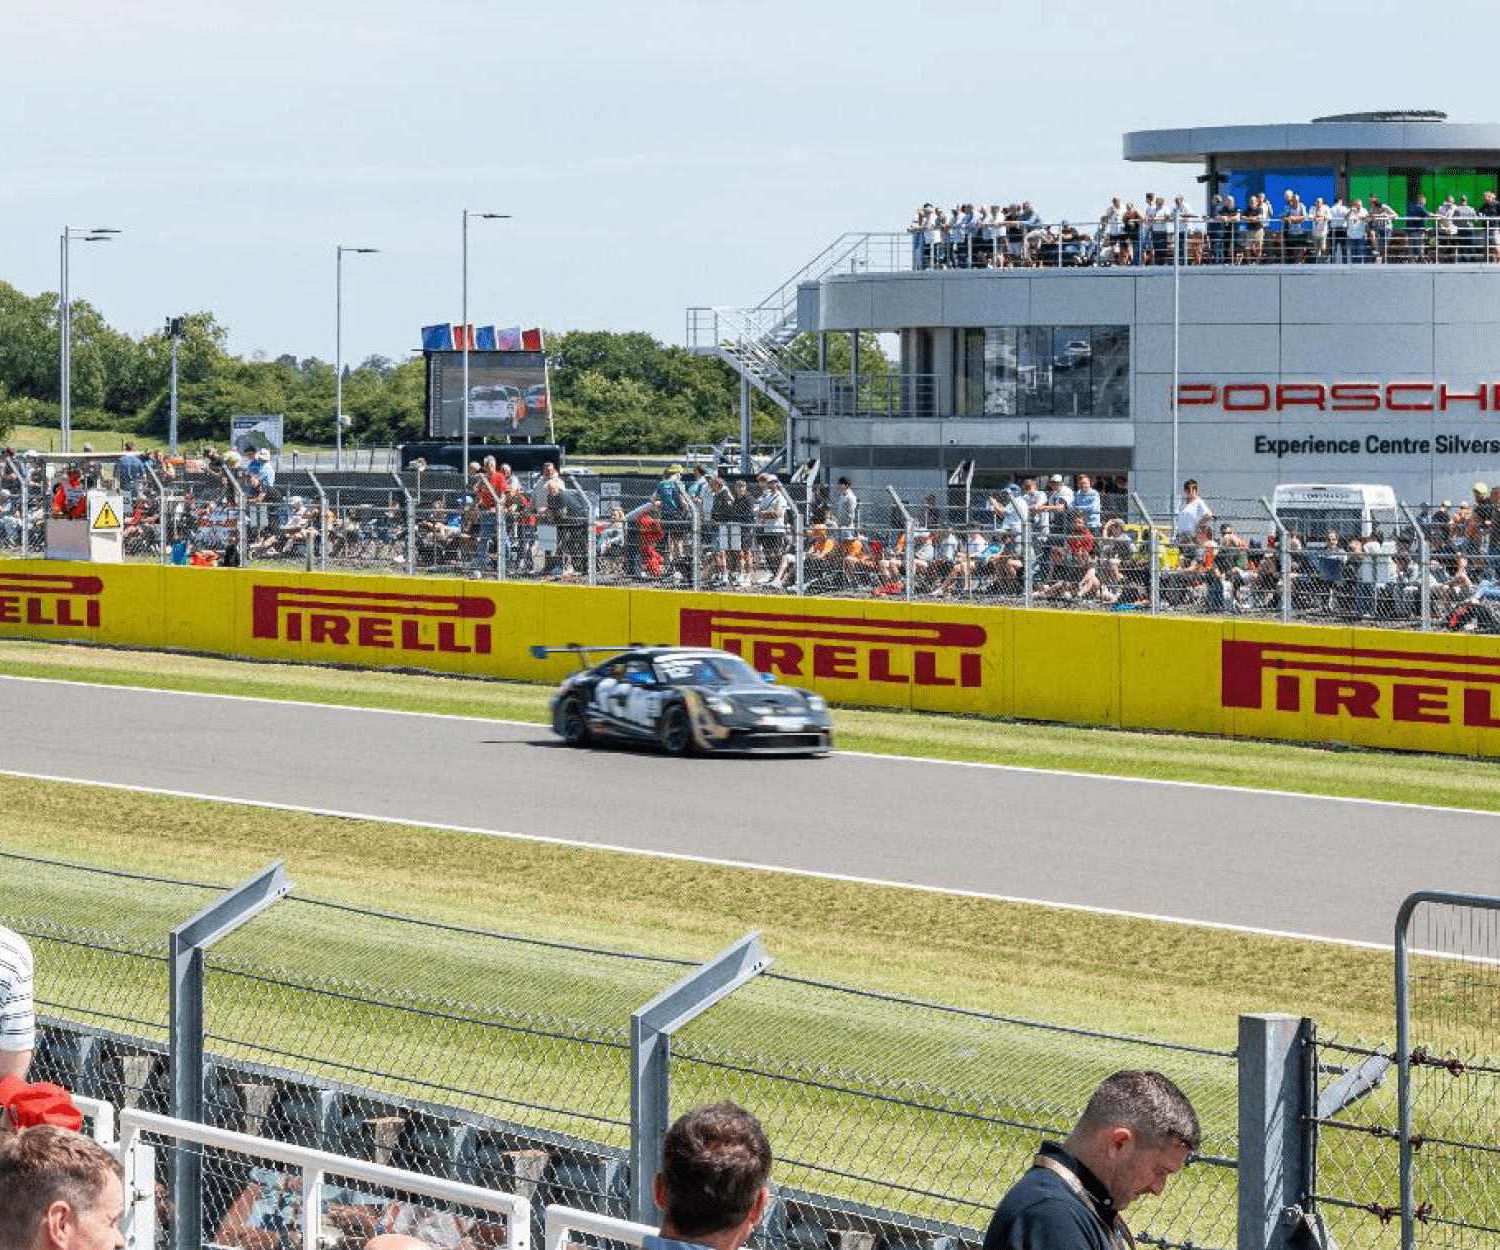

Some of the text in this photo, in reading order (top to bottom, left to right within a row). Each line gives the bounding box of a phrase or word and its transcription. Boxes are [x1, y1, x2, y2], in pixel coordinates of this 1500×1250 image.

[1171, 383, 1500, 412] PORSCH
[1254, 434, 1500, 458] Experience Centre Silvers
[252, 585, 496, 655] PIRELLI
